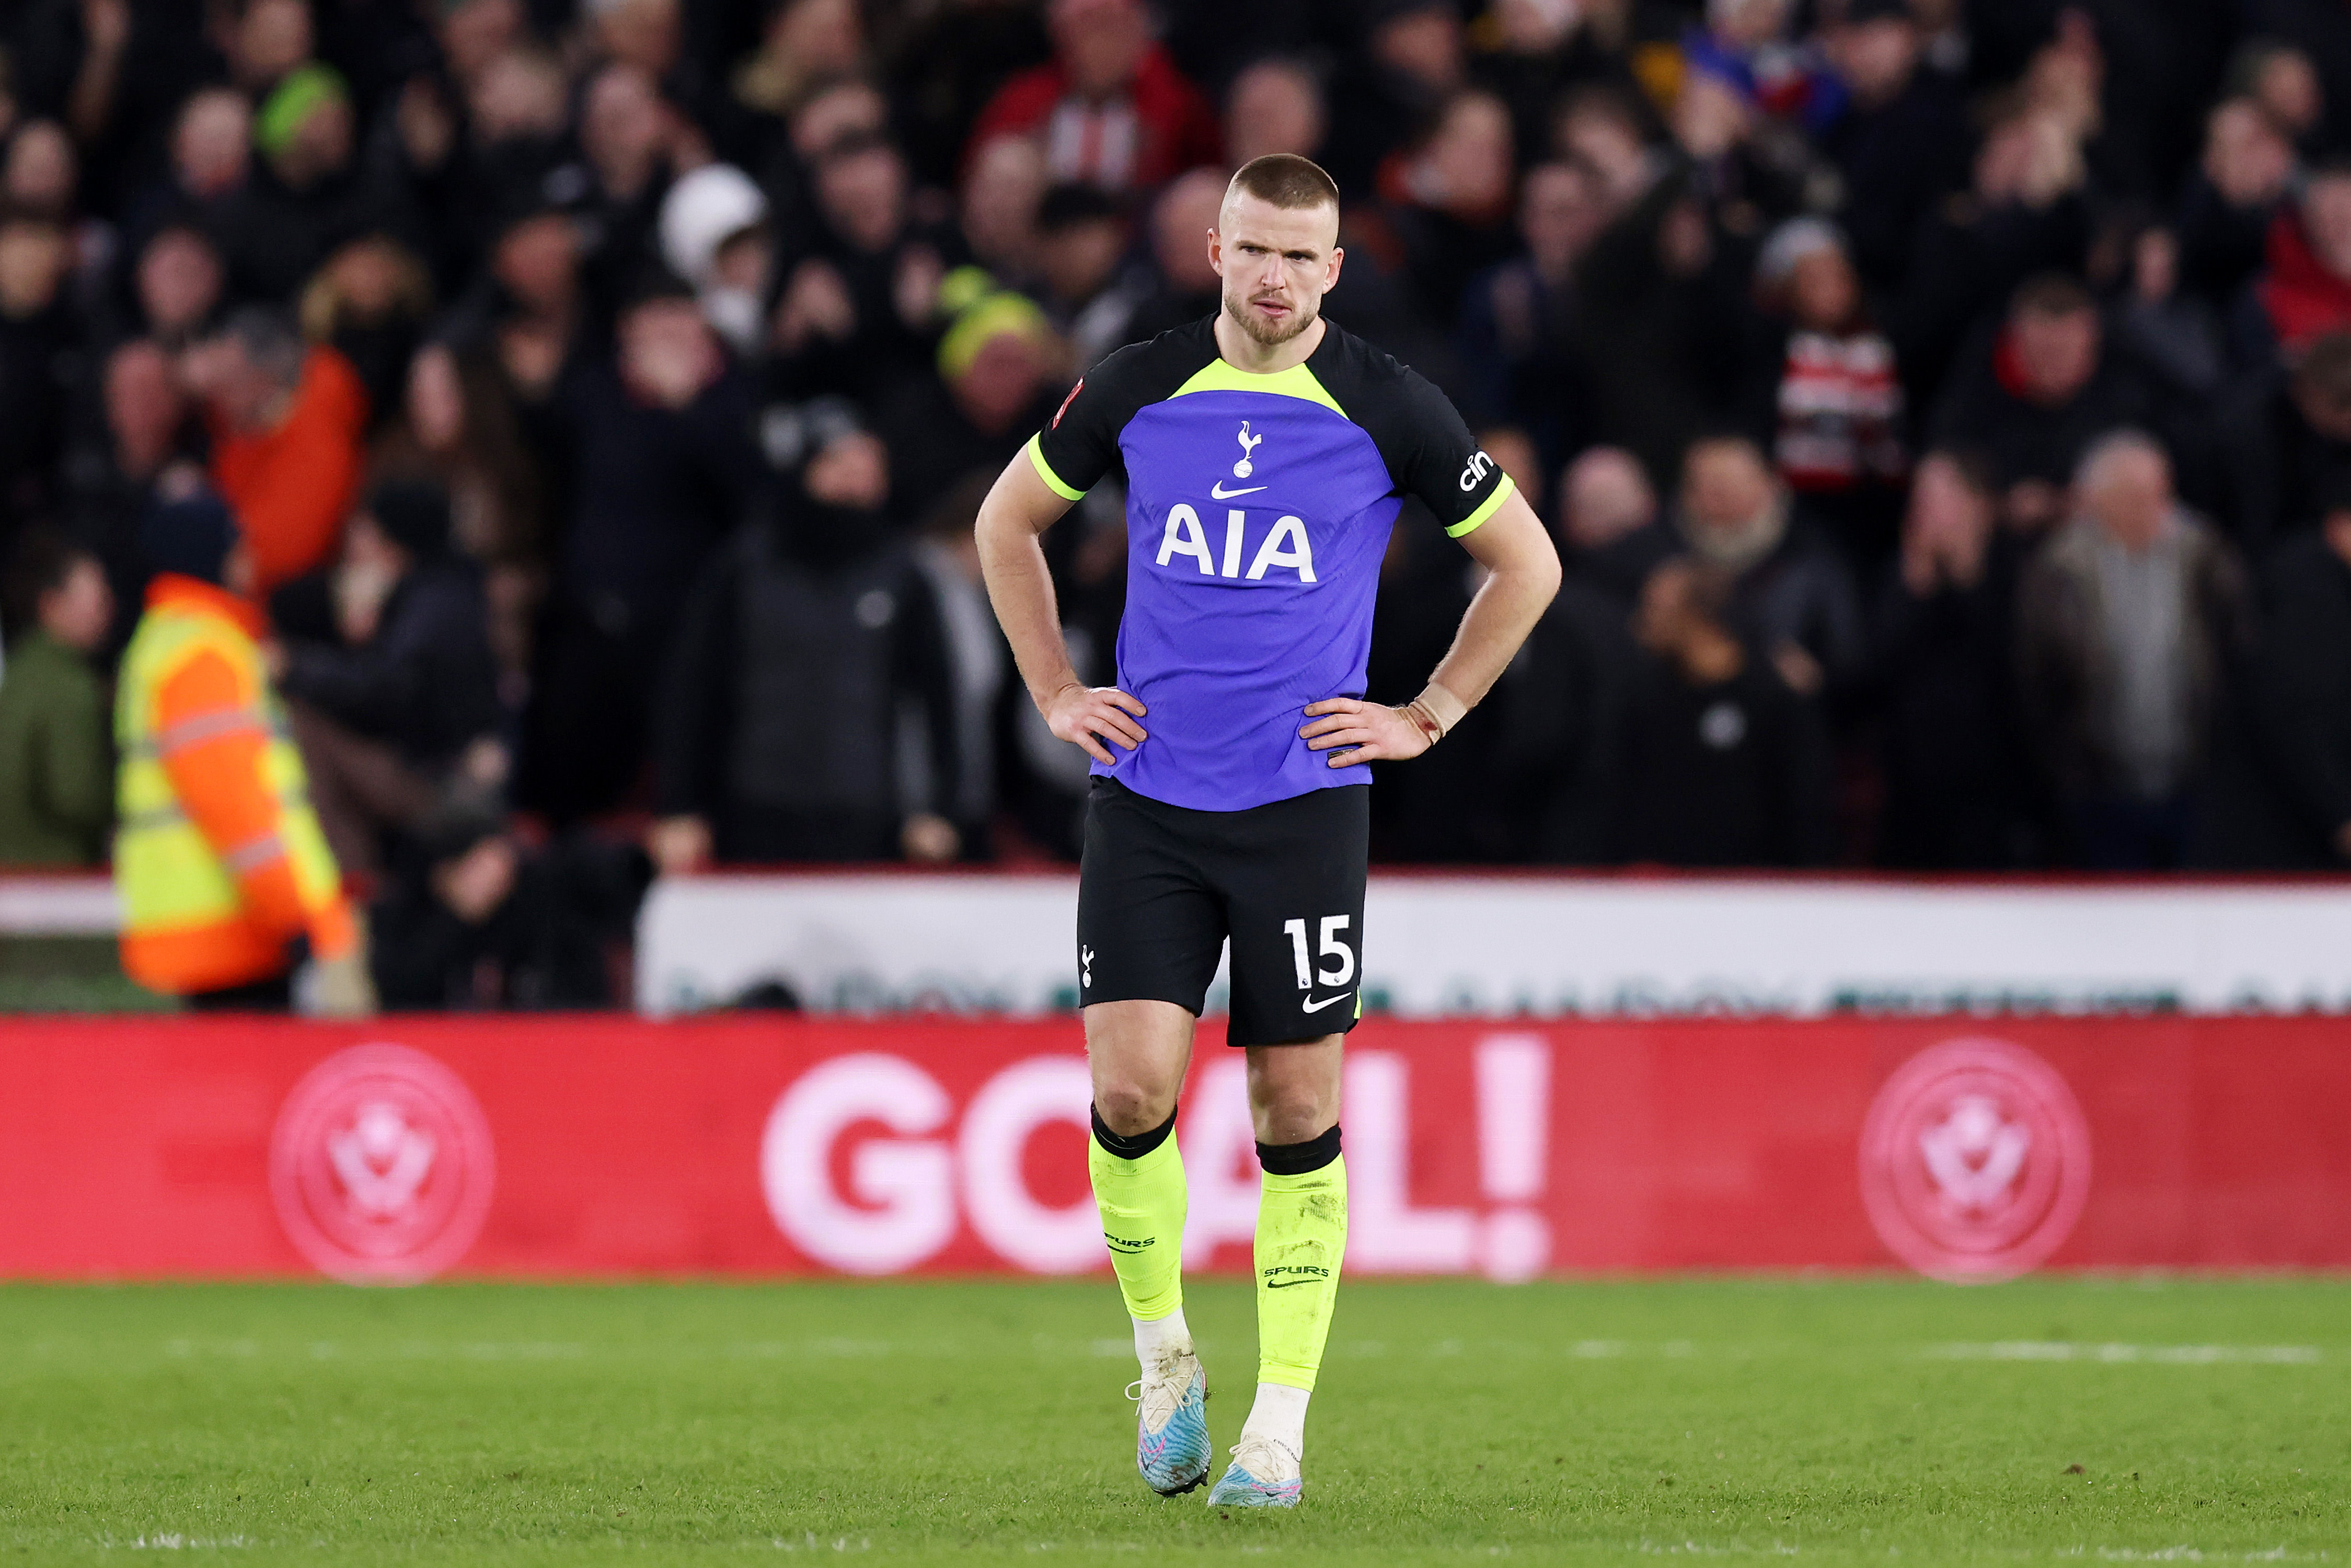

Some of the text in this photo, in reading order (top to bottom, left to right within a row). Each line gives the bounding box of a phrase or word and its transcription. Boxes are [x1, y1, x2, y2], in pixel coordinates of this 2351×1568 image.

[1156, 504, 1317, 583] AIA
[1283, 914, 1354, 989] 15
[1103, 1230, 1155, 1248] PURS
[1264, 1266, 1329, 1277] SPURS
